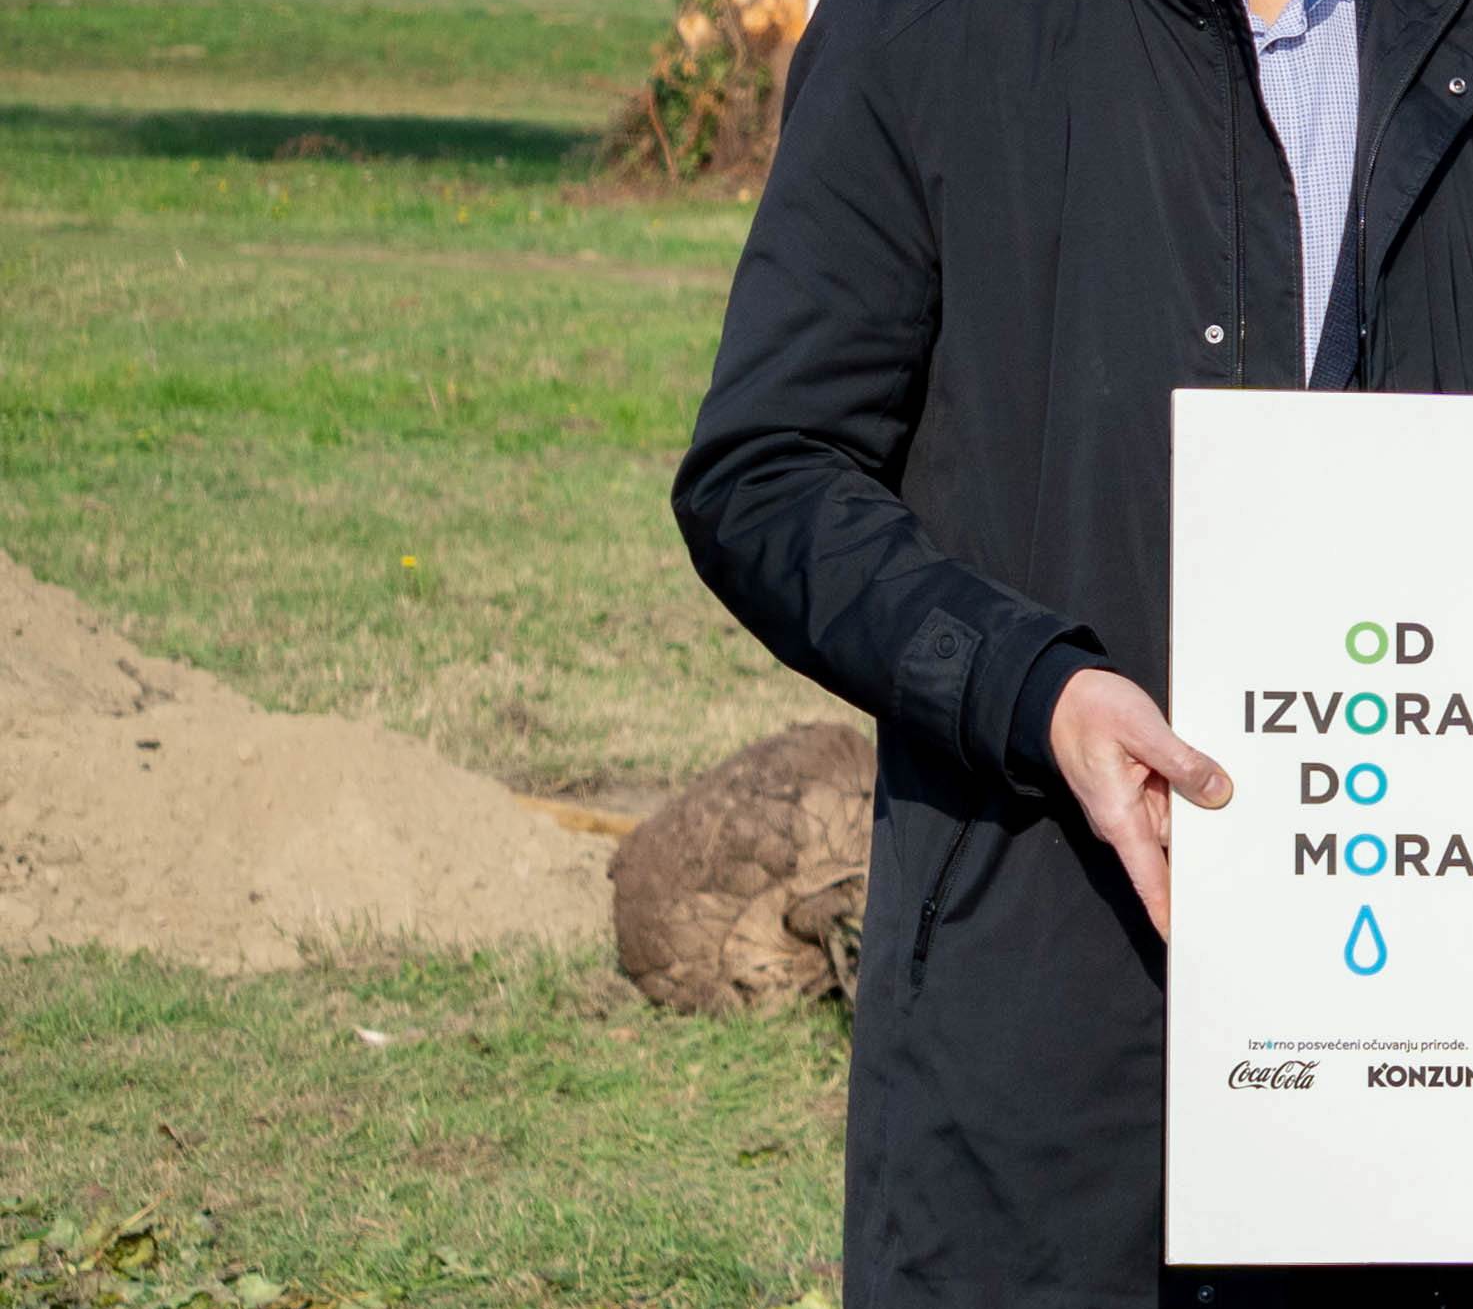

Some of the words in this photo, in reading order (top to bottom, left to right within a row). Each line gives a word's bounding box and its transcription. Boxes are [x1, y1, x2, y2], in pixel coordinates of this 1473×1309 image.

[1345, 621, 1435, 665] OD
[1300, 762, 1388, 807] DO
[1420, 1038, 1470, 1053] prirode.
[1228, 1059, 1321, 1090] Coca-Cola
